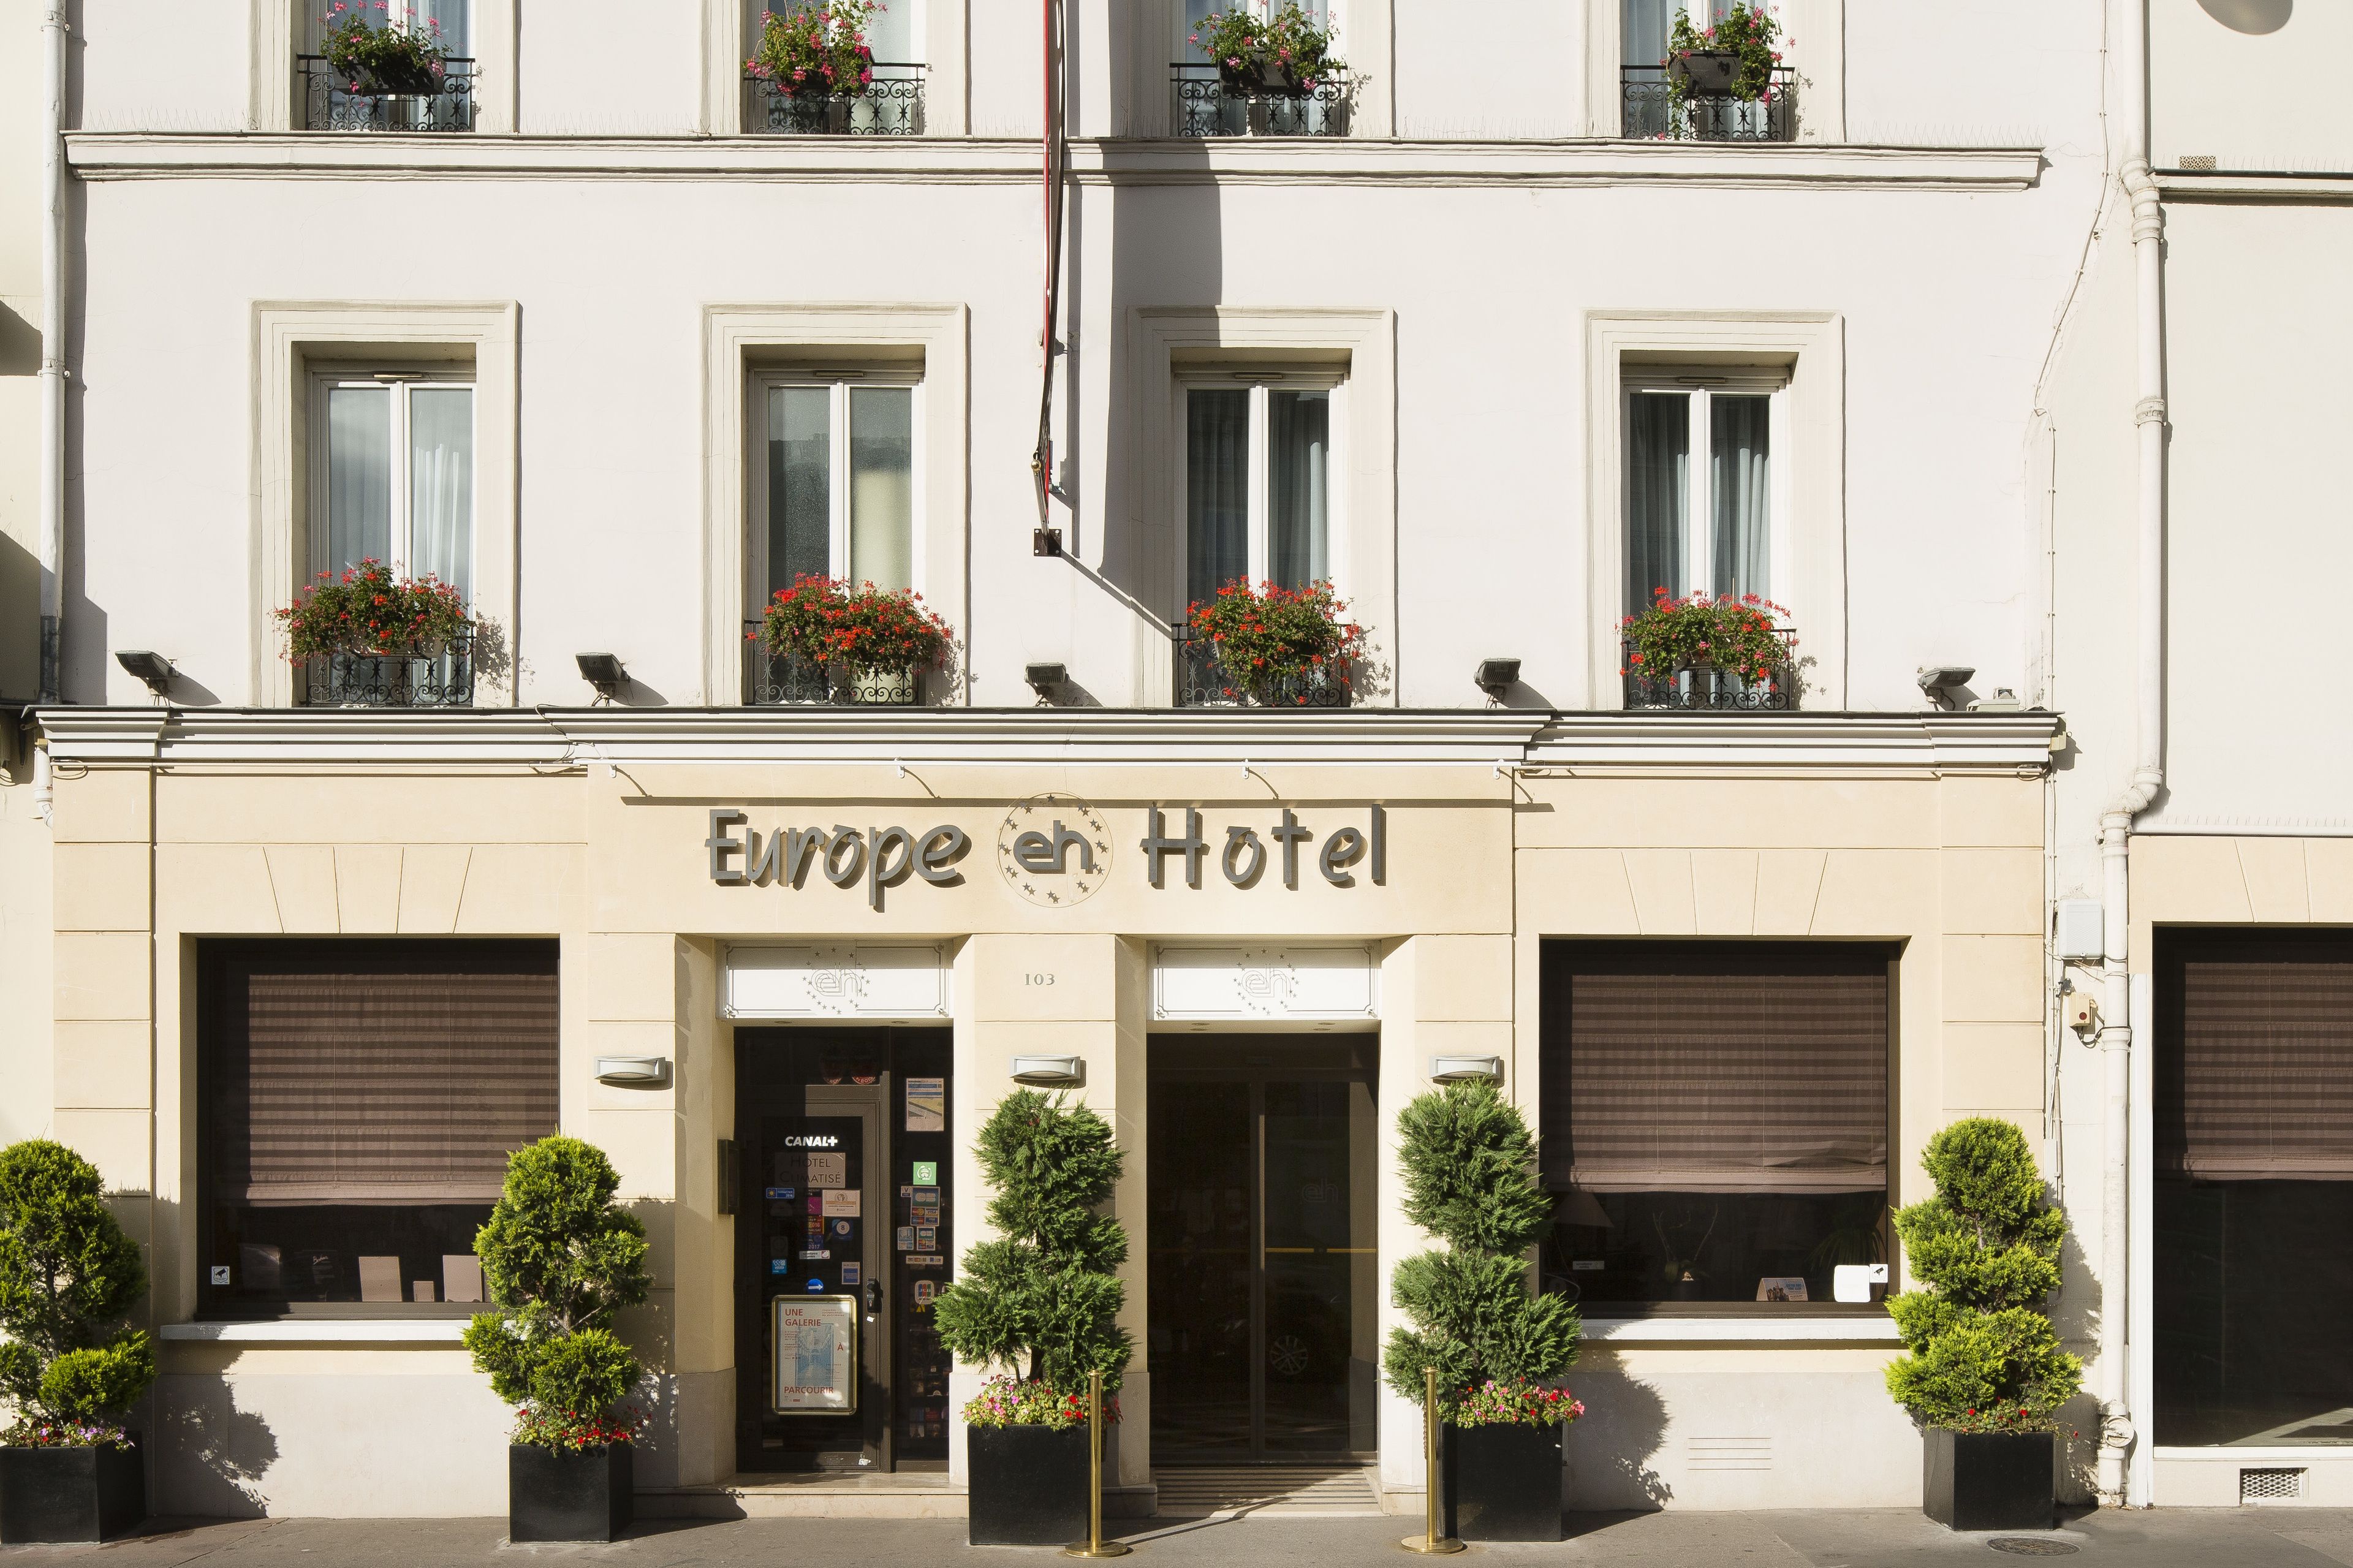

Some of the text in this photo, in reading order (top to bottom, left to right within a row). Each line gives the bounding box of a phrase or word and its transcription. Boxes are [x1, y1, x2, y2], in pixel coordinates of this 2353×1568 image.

[705, 809, 964, 907] Europe
[1140, 803, 1381, 885] Hotel
[1025, 973, 1055, 985] 103
[785, 1135, 838, 1146] CANAL+
[837, 1342, 844, 1351] À
